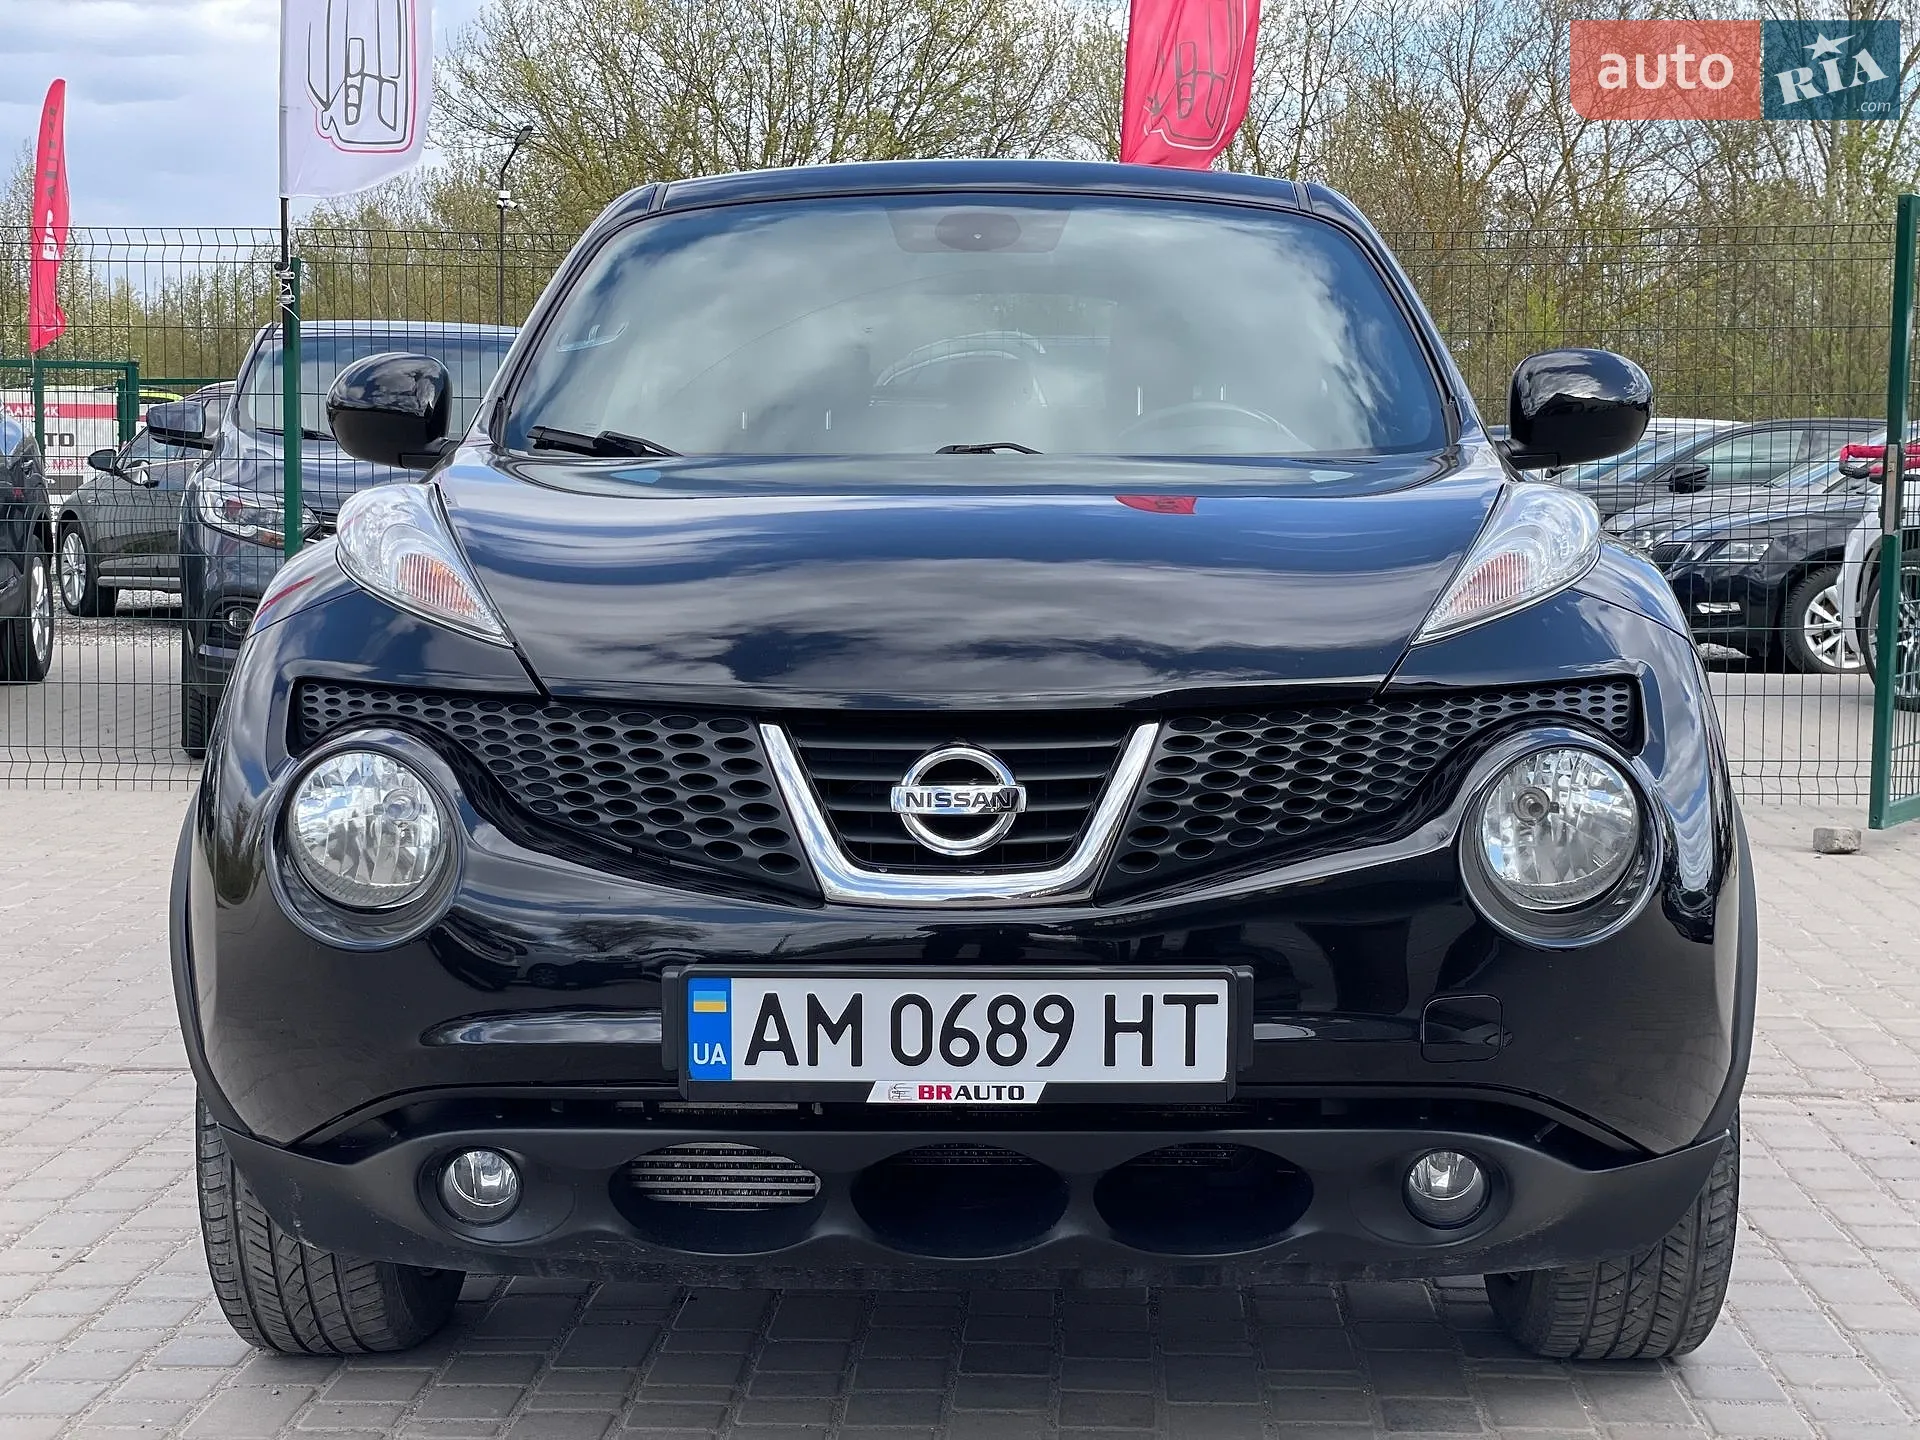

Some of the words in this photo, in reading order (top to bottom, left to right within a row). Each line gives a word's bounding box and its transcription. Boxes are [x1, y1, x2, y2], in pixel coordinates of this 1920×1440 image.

[905, 792, 1012, 808] NISSAN
[743, 992, 863, 1068] AM
[889, 992, 1075, 1068] 0689
[1103, 992, 1219, 1068] HT
[693, 1043, 727, 1067] UA
[917, 1084, 1025, 1101] BRAUTO
